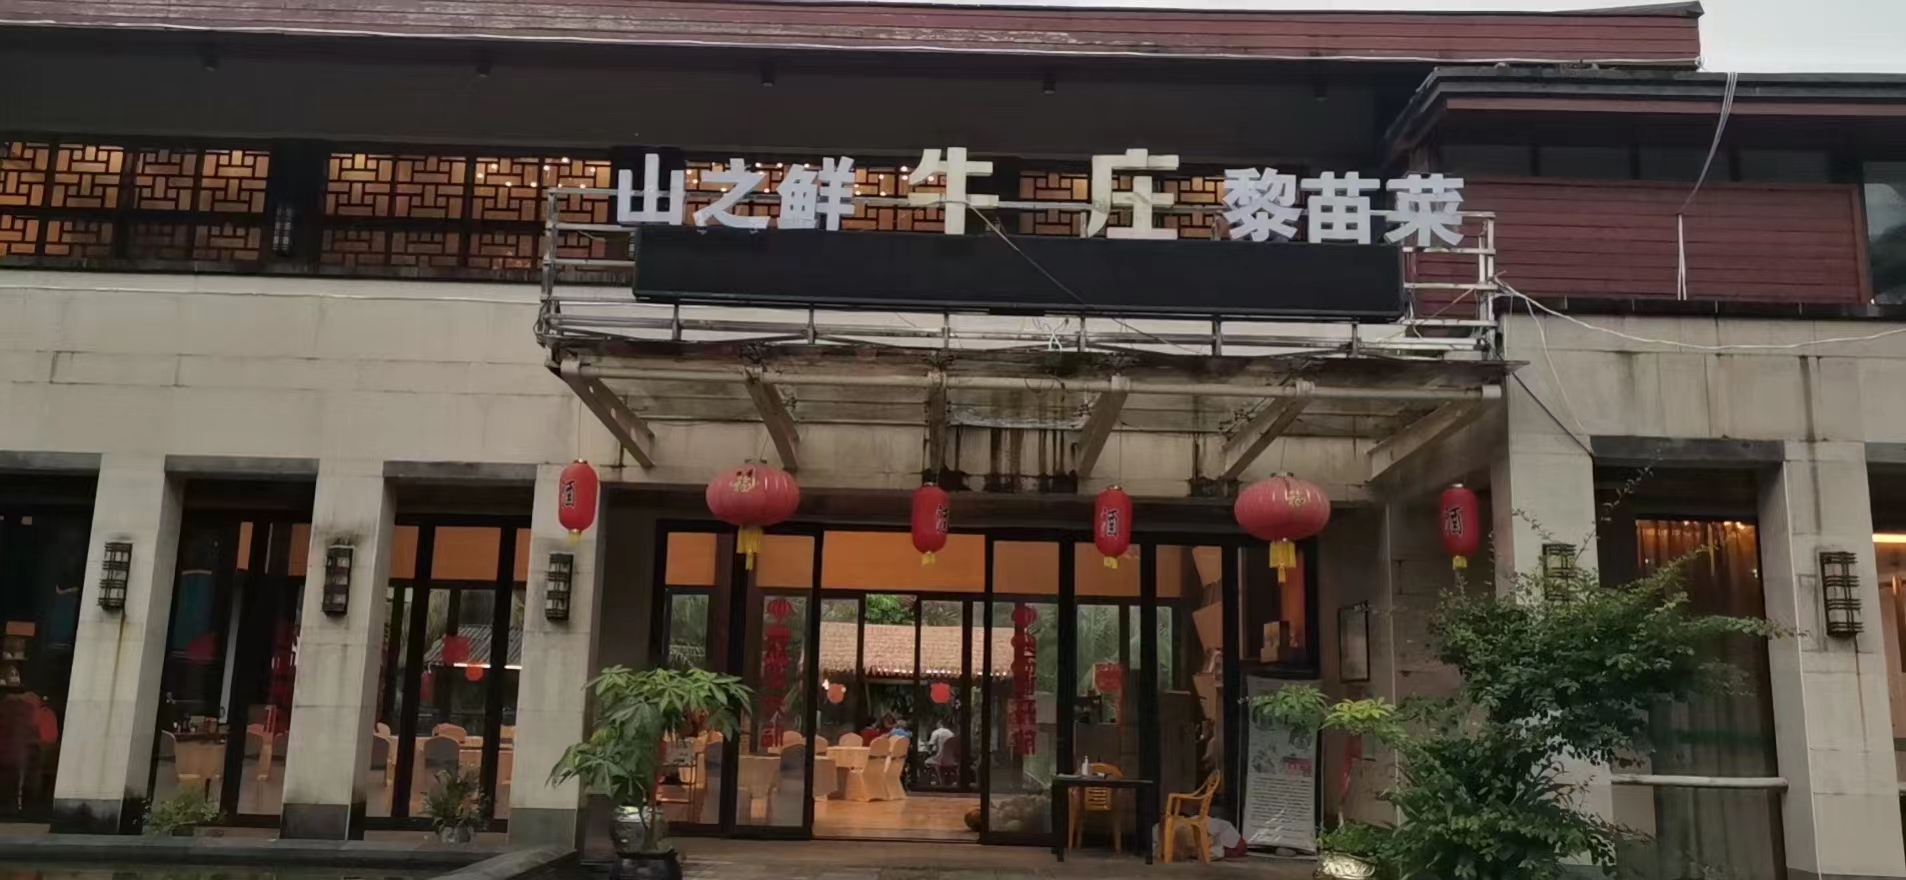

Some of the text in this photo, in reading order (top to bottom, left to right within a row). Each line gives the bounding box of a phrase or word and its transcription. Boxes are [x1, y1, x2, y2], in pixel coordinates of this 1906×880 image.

[617, 147, 1465, 247] 山之鲜 牛庄 黎苗菜
[1100, 507, 1119, 537] 酒
[1445, 506, 1463, 537] 酒
